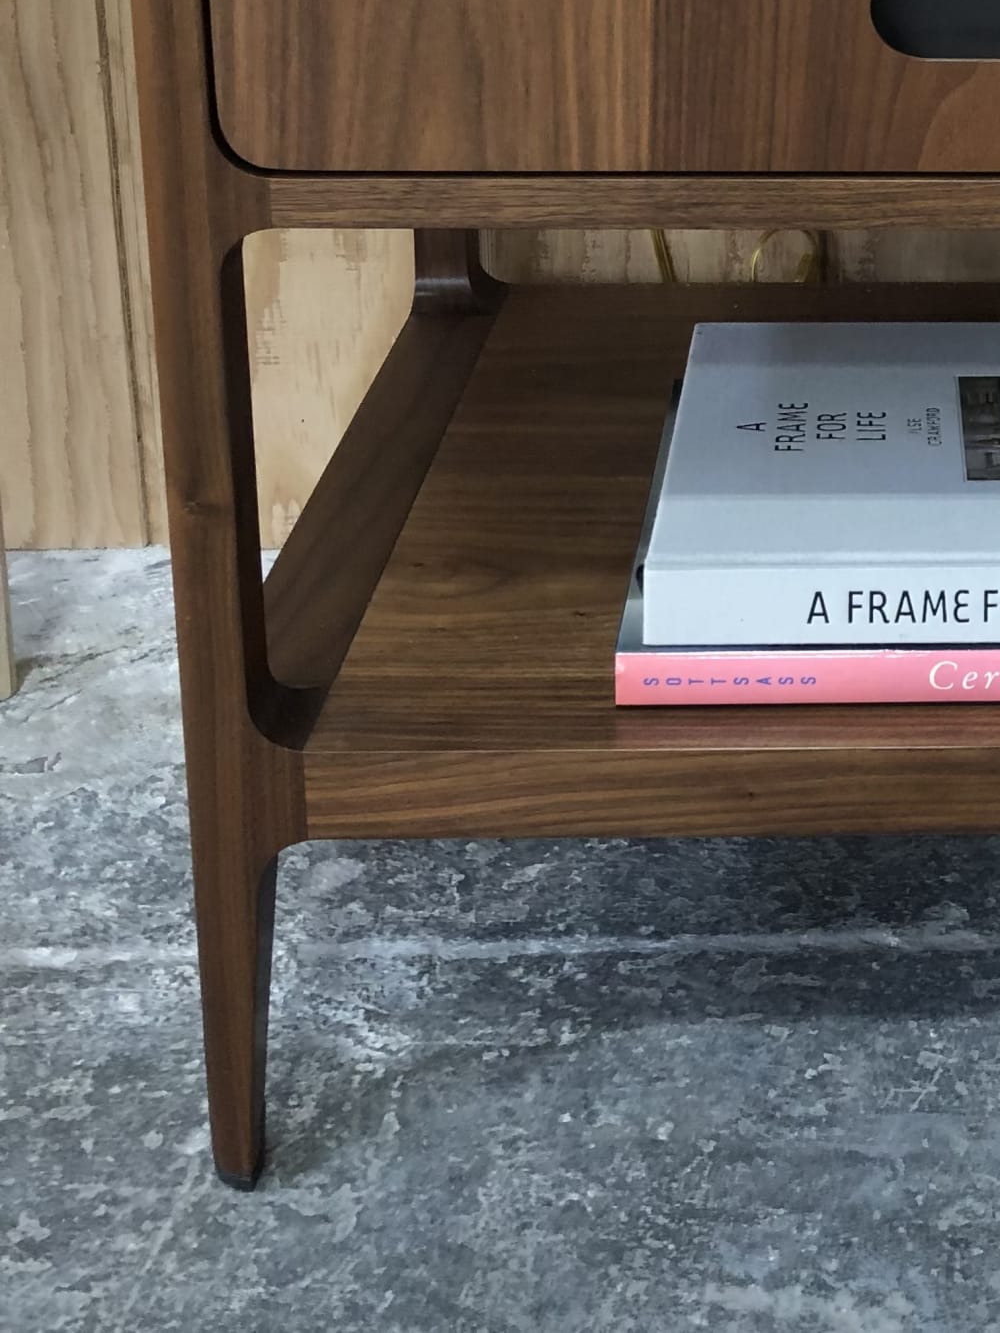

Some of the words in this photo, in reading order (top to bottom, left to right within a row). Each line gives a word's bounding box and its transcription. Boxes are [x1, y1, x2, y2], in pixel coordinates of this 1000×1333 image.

[735, 421, 767, 433] A
[773, 402, 809, 452] FRAME
[816, 412, 847, 440] FOR
[855, 411, 887, 441] LIFE
[925, 406, 943, 448] CRAWFORD
[806, 590, 831, 625] A
[847, 589, 971, 624] FRAME
[642, 675, 818, 687] SOTTSASS
